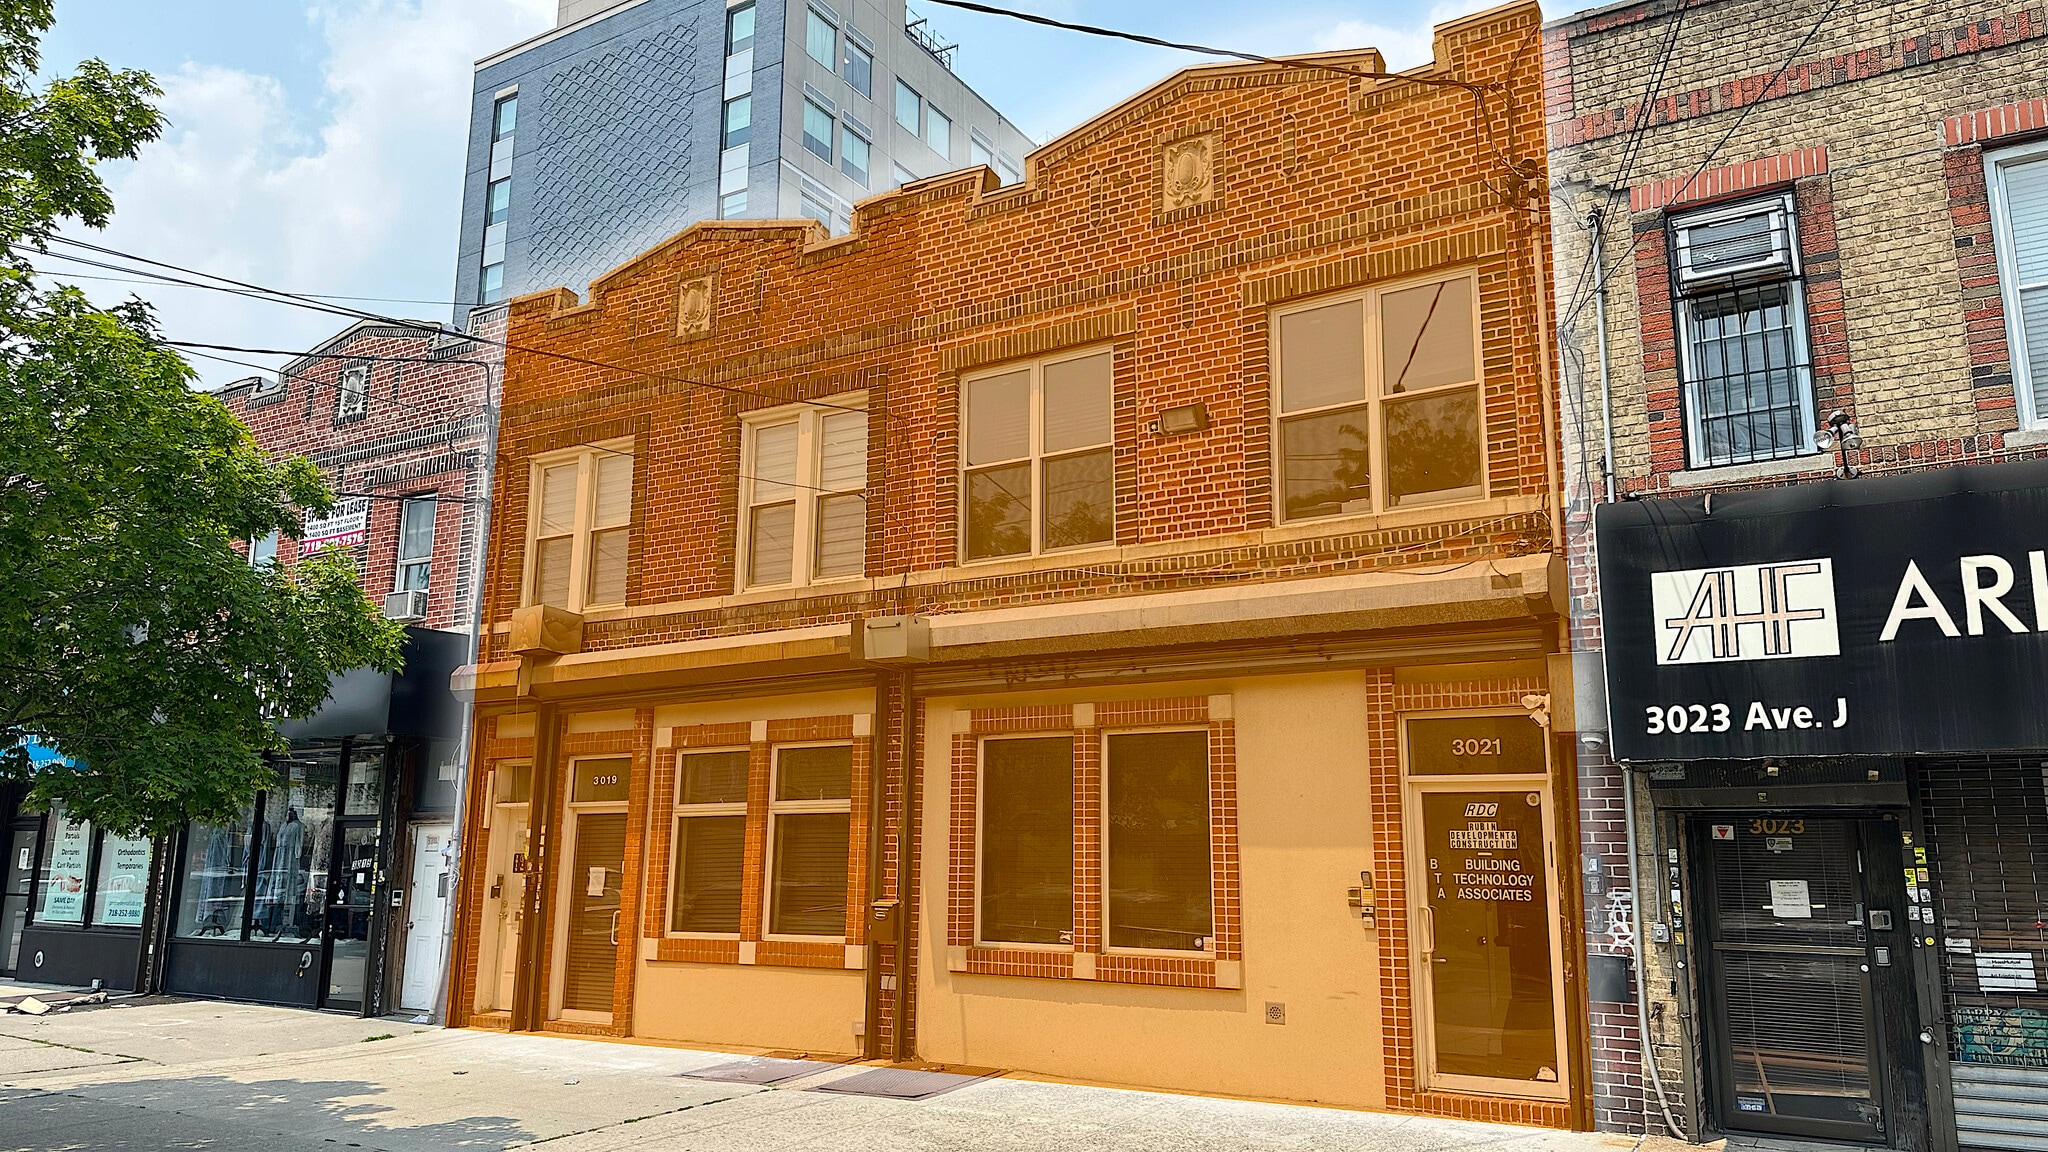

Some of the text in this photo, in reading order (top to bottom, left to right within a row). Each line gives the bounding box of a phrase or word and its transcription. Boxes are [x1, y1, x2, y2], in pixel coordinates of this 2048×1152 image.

[331, 503, 346, 519] FOR
[346, 499, 367, 516] LEASE
[307, 524, 319, 532] 1400
[319, 522, 327, 530] SQ
[335, 519, 344, 527] 1ST
[344, 515, 360, 525] FLOOR
[309, 530, 321, 538] 1400
[321, 529, 329, 537] SQ
[336, 522, 362, 534] BASEMENT
[1879, 550, 2048, 642] ARI
[1646, 697, 1850, 735] 3023 Ave. J
[1451, 738, 1501, 756] 3021
[593, 775, 618, 786] 3019
[1466, 803, 1498, 816] RDC
[1469, 822, 1496, 832] RUBIN
[1748, 819, 1806, 835] 3023
[65, 832, 80, 840] Partials
[1451, 840, 1517, 849] CONSTRUCTION
[61, 848, 80, 856] Dentures
[117, 848, 146, 856] Orthodontics
[66, 861, 81, 869] Partials
[117, 862, 144, 870] Temporaries
[1430, 858, 1521, 871] B BUILDING
[1434, 872, 1535, 887] T TECHNOLOGY
[54, 896, 76, 904] SAME DAY
[1437, 888, 1532, 901] A ASSOCIATES
